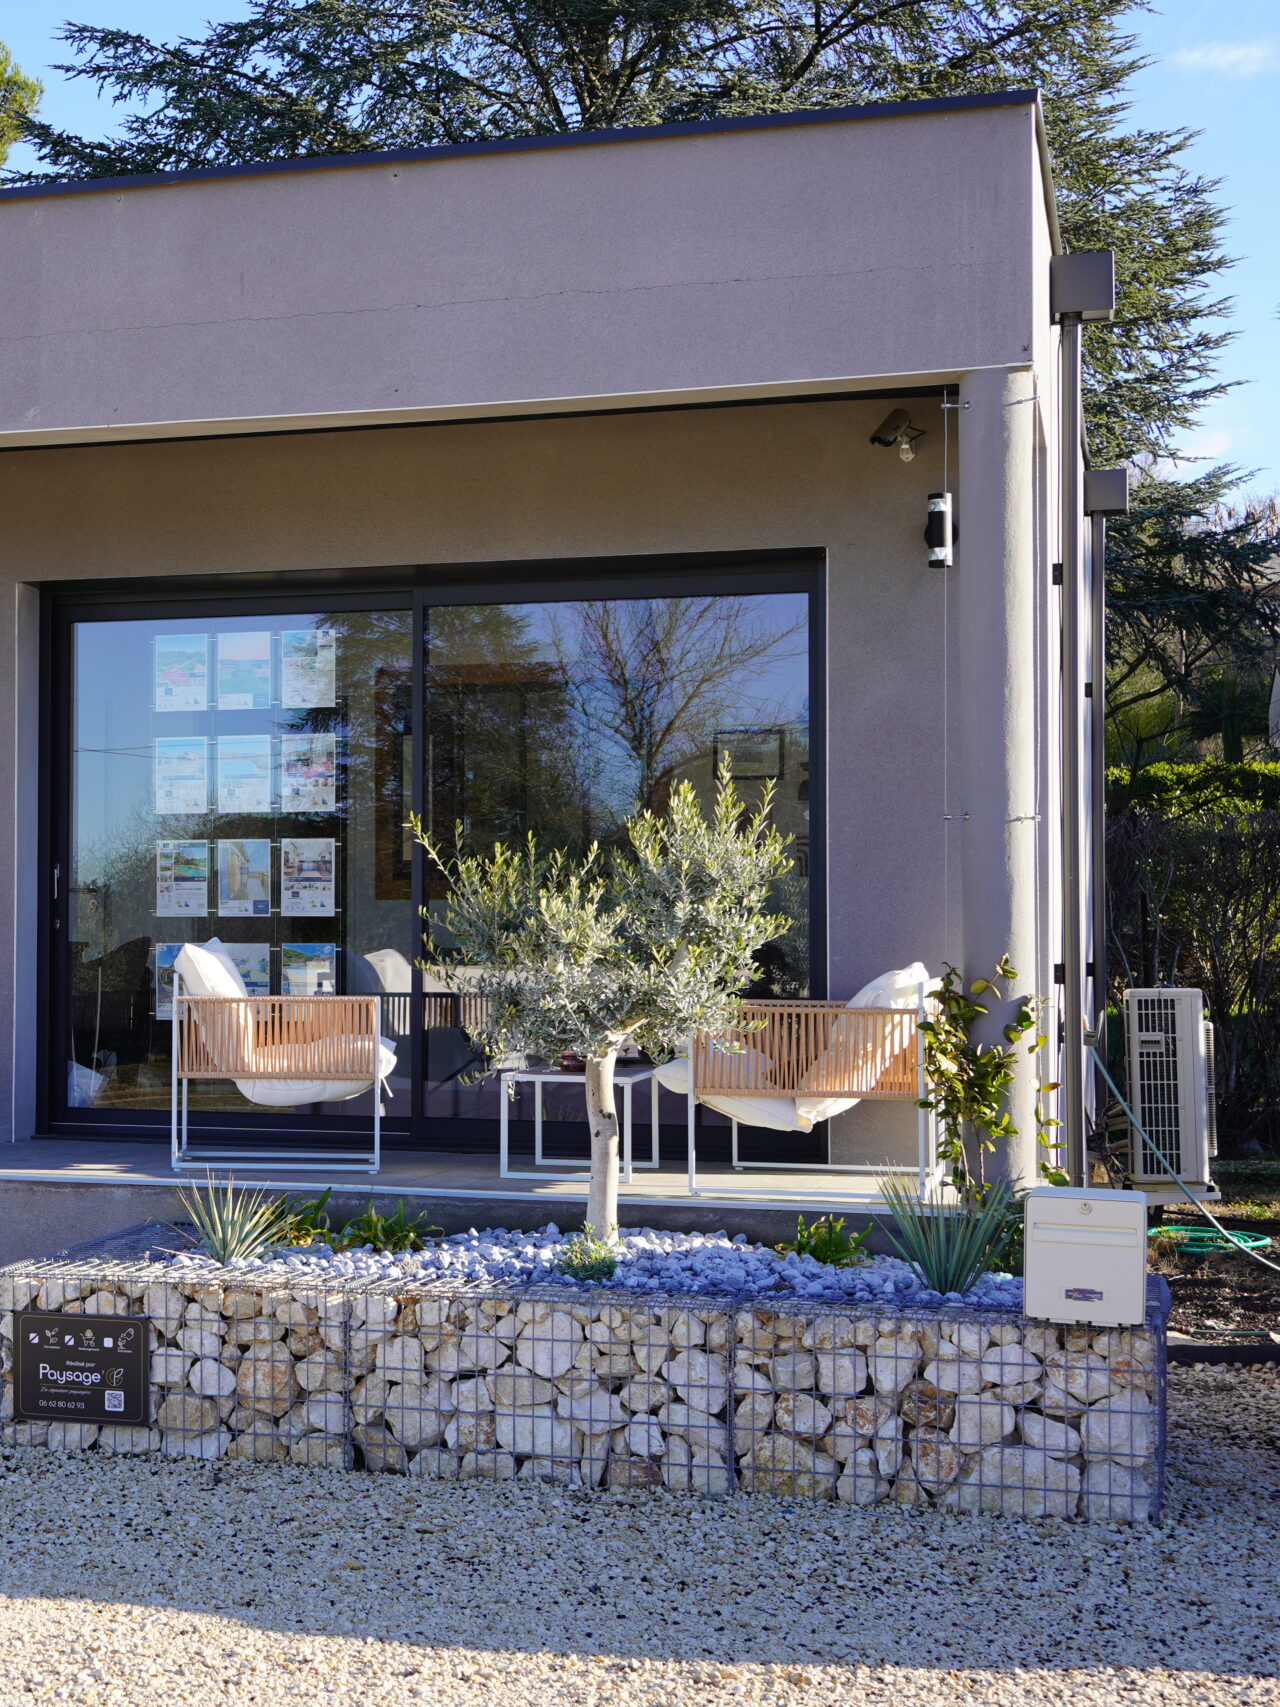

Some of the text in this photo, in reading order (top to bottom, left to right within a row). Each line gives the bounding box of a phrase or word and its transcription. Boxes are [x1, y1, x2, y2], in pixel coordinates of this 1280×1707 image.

[39, 1399, 48, 1407] 06
[48, 1400, 57, 1408] 62
[76, 1402, 85, 1410] 93
